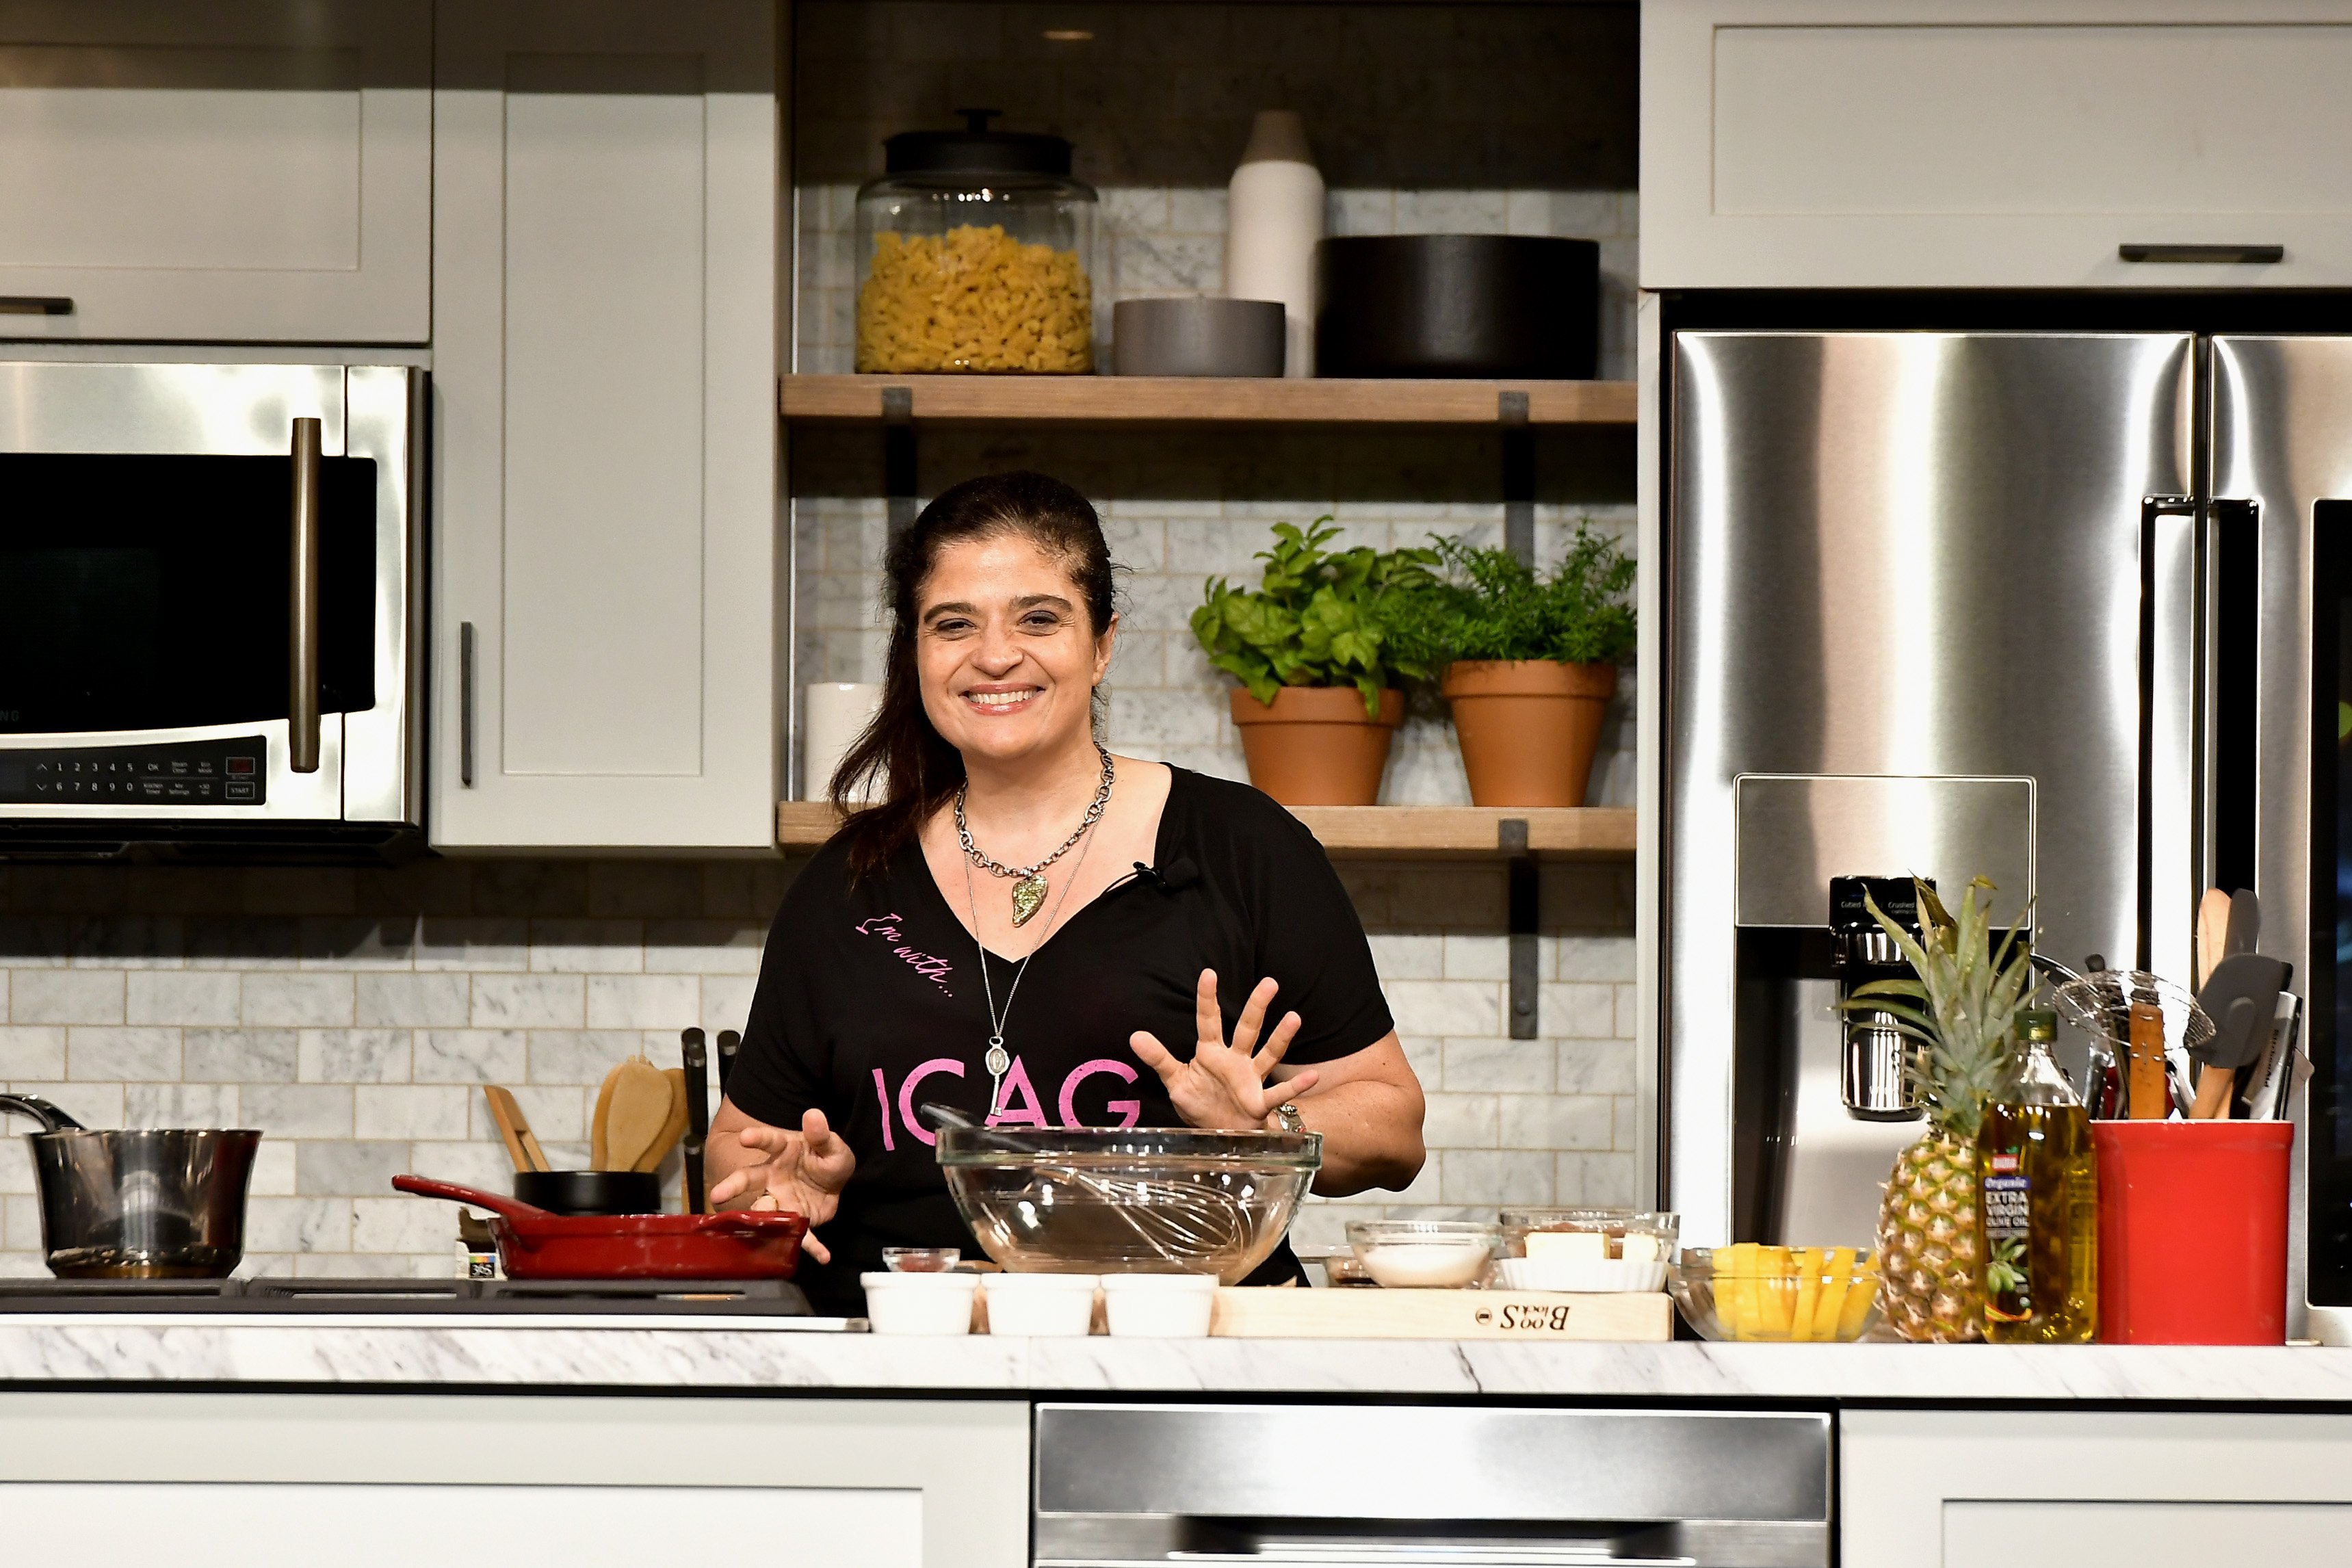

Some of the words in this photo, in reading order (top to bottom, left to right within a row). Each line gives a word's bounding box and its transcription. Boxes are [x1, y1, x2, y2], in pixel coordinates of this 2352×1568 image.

[57, 763, 62, 772] 1
[75, 763, 81, 772] 2
[92, 763, 98, 772] 3
[109, 763, 116, 772] 4
[127, 763, 133, 772] 5
[147, 763, 159, 772] OK
[56, 782, 62, 791] 6
[75, 782, 80, 791] 7
[92, 782, 98, 791] 8
[109, 782, 115, 791] 9
[127, 782, 133, 791] 0
[1985, 1191, 2028, 1205] EXTRA
[1986, 1203, 2030, 1217] VIRGIN
[1986, 1216, 2011, 1227] OLIVE
[2012, 1216, 2030, 1227] OIL
